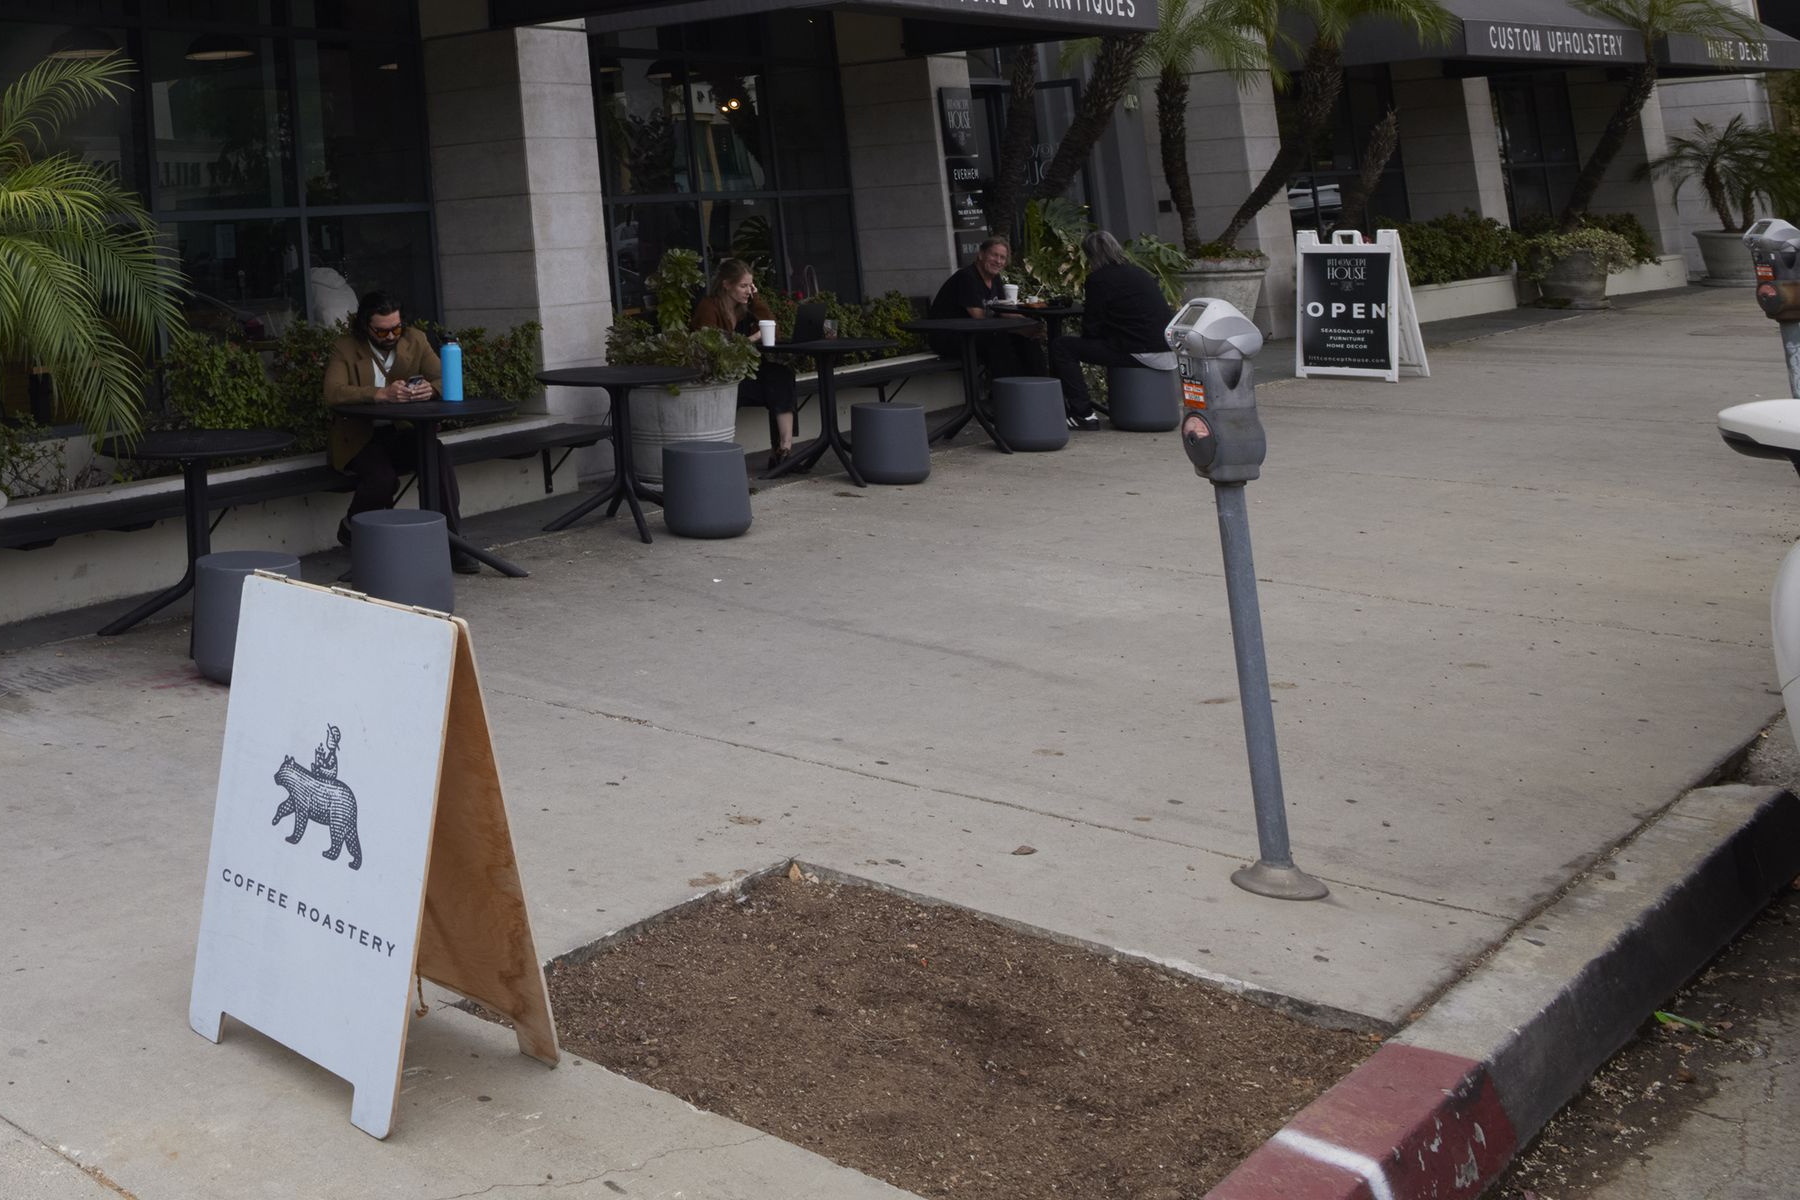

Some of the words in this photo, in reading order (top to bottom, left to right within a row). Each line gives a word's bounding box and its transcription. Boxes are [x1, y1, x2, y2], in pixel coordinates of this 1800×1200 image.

[1489, 26, 1541, 52] CUSTOM
[1547, 31, 1623, 56] UPHOLSTERY
[1707, 40, 1734, 60] HOME
[1739, 42, 1770, 62] DECOR
[1327, 267, 1367, 280] HOUSE
[1306, 301, 1387, 319] OPEN
[222, 868, 288, 909] COFFEE
[297, 901, 395, 957] ROASTERY
